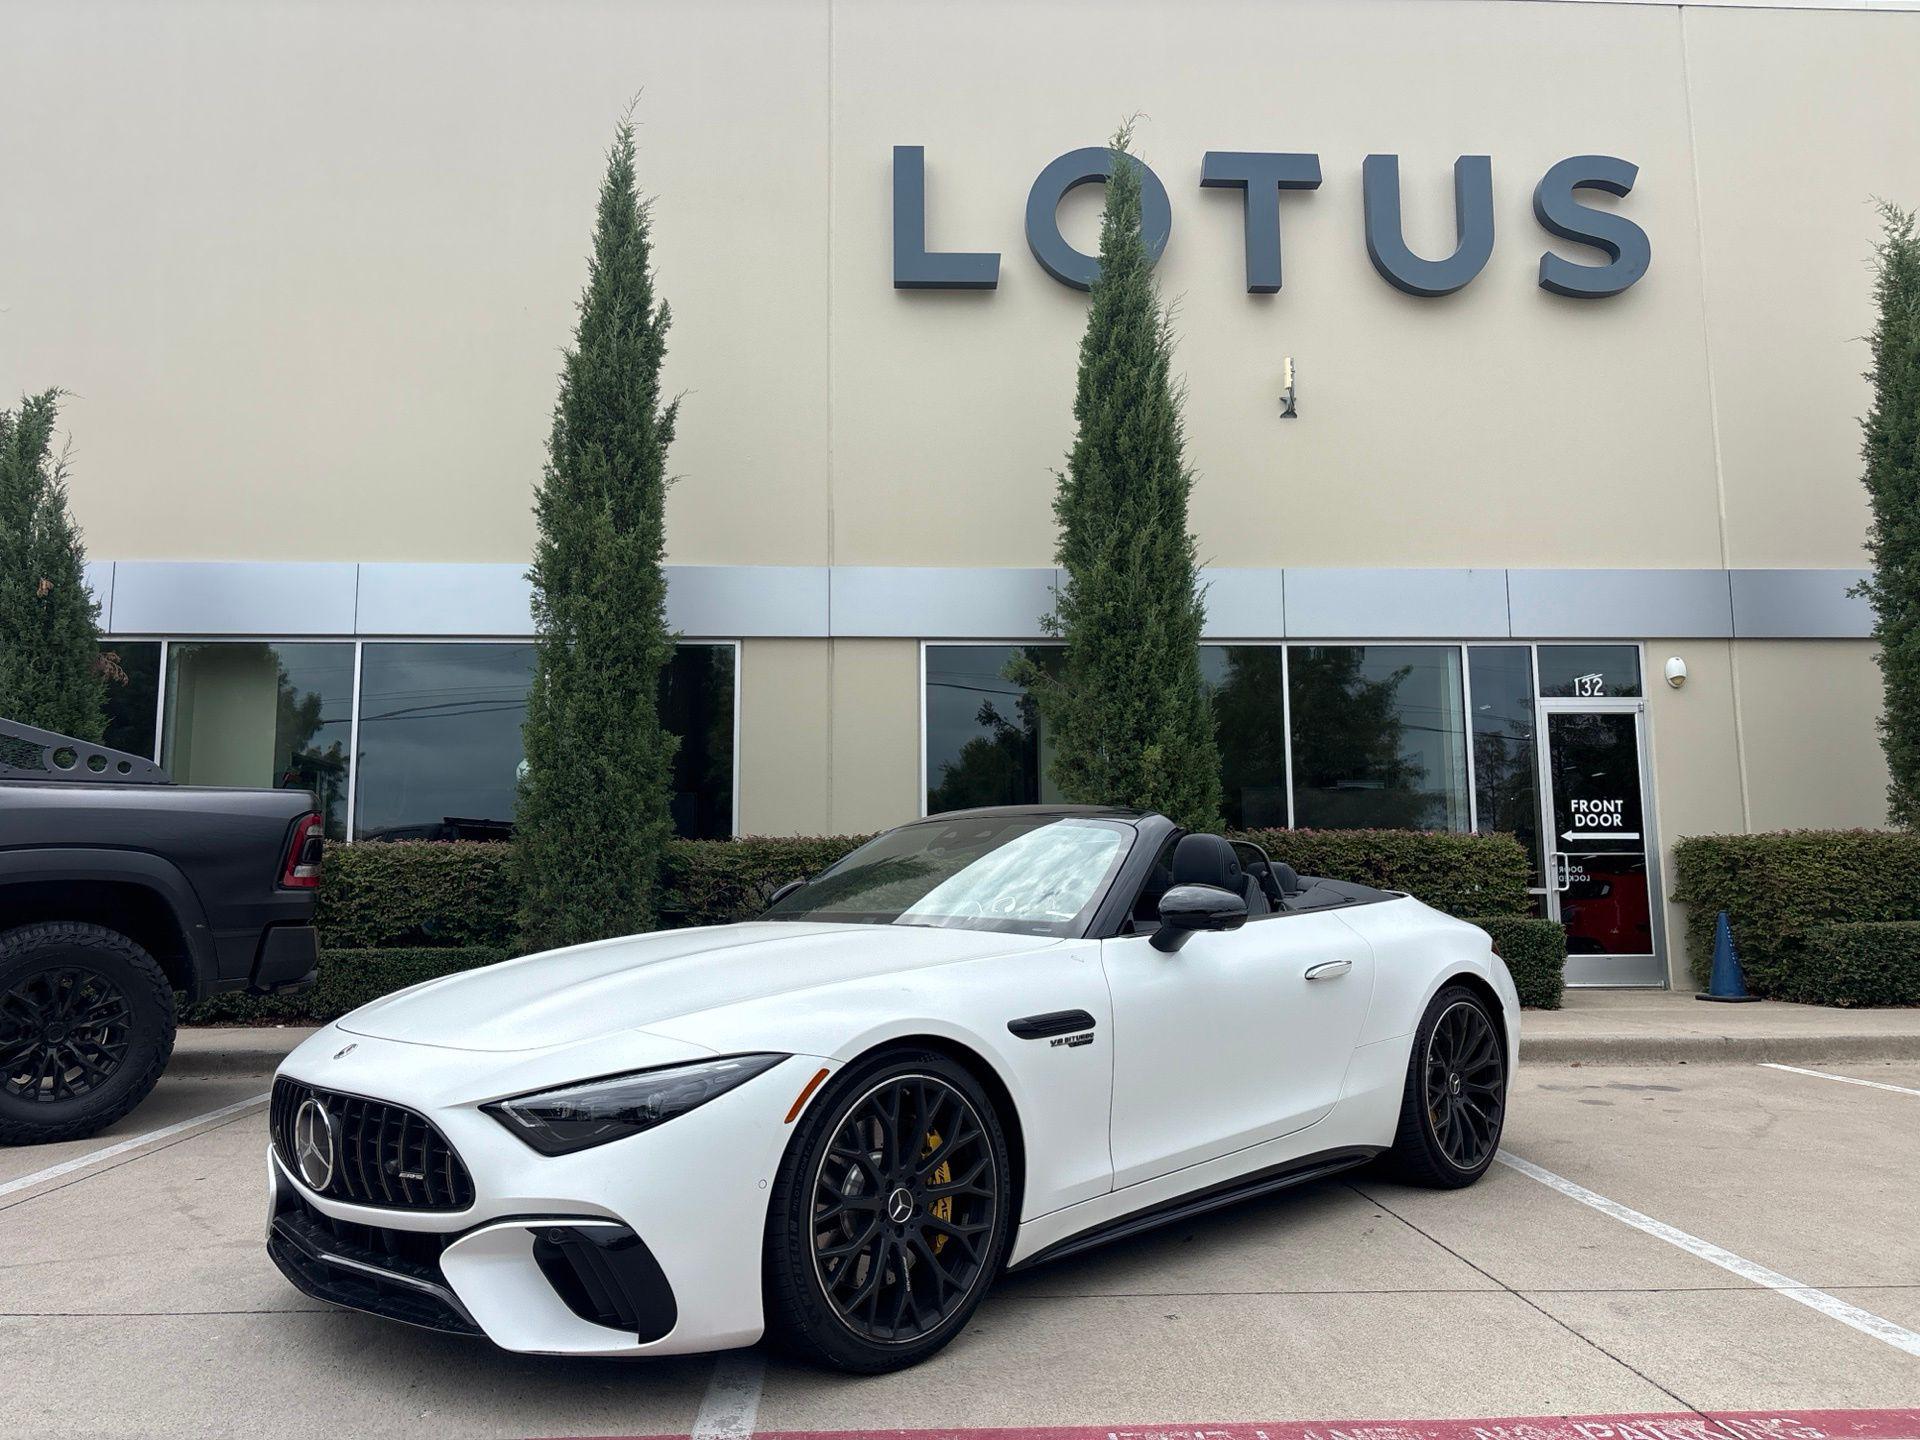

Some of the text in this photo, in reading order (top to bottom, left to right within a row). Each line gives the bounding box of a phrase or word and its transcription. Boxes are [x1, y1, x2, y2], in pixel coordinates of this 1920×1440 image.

[892, 145, 1652, 299] LOTUS
[1573, 677, 1604, 697] 132
[1571, 799, 1624, 813] FRONT
[1574, 813, 1623, 827] DOOR
